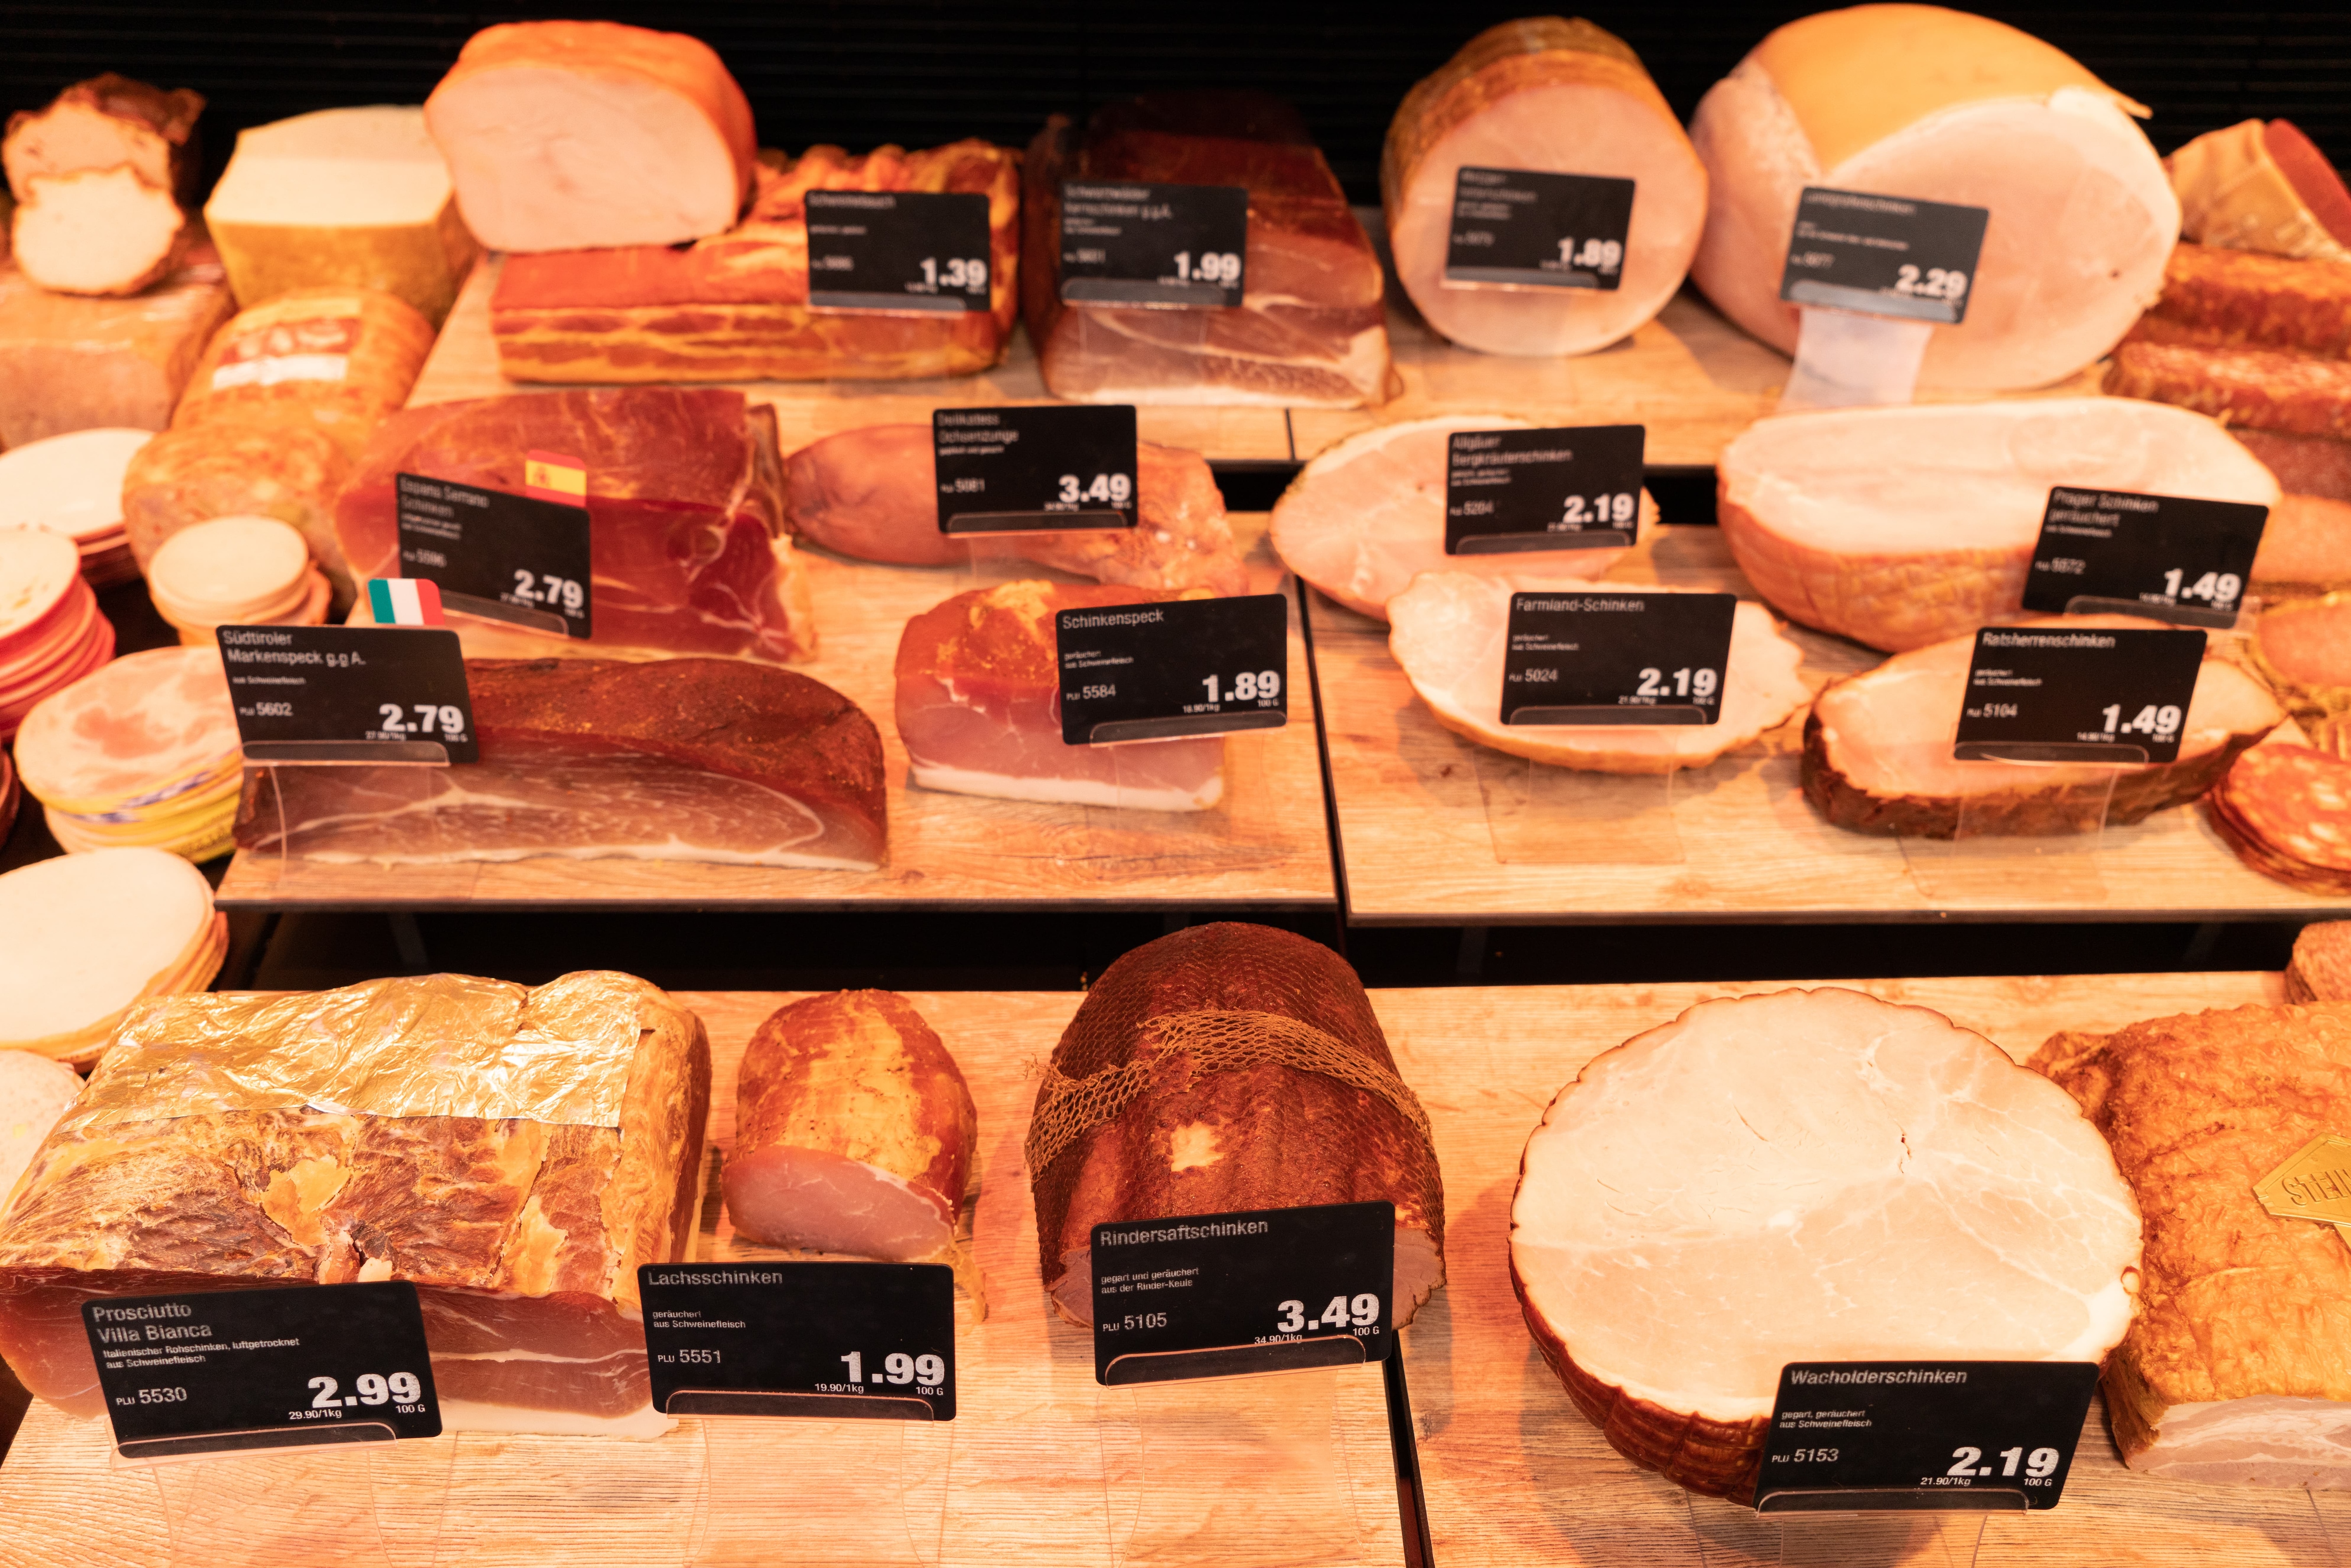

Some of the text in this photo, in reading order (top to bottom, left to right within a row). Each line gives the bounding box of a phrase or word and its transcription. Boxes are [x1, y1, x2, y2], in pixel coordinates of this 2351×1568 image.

[1558, 237, 1622, 267] 1.89
[920, 257, 987, 287] 1.39
[1174, 251, 1241, 281] 1.99
[1895, 264, 1968, 298] 2.29
[1058, 473, 1131, 503] 3.49
[1563, 493, 1635, 523] 2.19
[514, 569, 584, 609] 2.79
[2164, 568, 2241, 602] 1.49
[1517, 598, 1645, 612] Farmland-Schinken
[1063, 609, 1164, 630] Schinkenspeck
[223, 630, 292, 646] Südtiroler
[1982, 632, 2116, 648] Ratsherrenschinken
[228, 649, 323, 665] Markenspeck
[1524, 668, 1558, 683] 5024
[1636, 667, 1718, 698] 2.19
[1082, 684, 1117, 700] 5584
[1202, 670, 1280, 703] 1.89
[256, 702, 294, 717] 5602
[1983, 703, 2018, 718] 5104
[379, 703, 465, 734] 2.79
[2102, 703, 2182, 734] 1.49
[1100, 1221, 1268, 1246] Rindersaftschinken
[648, 1271, 783, 1285] Lachsschinken
[1101, 1267, 1199, 1285] gegart und geräuchert
[1101, 1278, 1193, 1294] aus der Rinder-Keule
[93, 1303, 192, 1323] Prosciutto
[653, 1310, 702, 1319] geräuchert
[1277, 1293, 1380, 1333] 3.49
[672, 1320, 746, 1329] Schweinefleisch
[1103, 1312, 1168, 1332] PLU 5105
[97, 1324, 213, 1343] Villa Bianca
[1254, 1333, 1303, 1344] 34.90/1kg
[1353, 1326, 1380, 1336] 100 G
[103, 1338, 300, 1358] Italienischer Rohschinken, luftgetrocknet
[106, 1355, 206, 1369] aus Schweinefleisch
[657, 1349, 721, 1364] PLU 5551
[840, 1351, 945, 1386] 1.99
[1791, 1369, 1967, 1385] Wacholderschinken
[116, 1387, 188, 1406] PLU 5530
[308, 1371, 422, 1408] 2.99
[814, 1383, 864, 1394] 19.90/1kg
[916, 1387, 944, 1396] 100 G
[288, 1409, 342, 1420] 29.90/1kg
[395, 1403, 426, 1414] 100 G
[1781, 1410, 1866, 1420] gegart, geräuchert
[1799, 1419, 1872, 1429] Schweinefleisch
[1772, 1448, 1839, 1463] PLU 5153
[1946, 1446, 2060, 1477] 2.19
[1920, 1477, 1971, 1487] 21.90/1kg
[2023, 1477, 2053, 1487] 100 G
